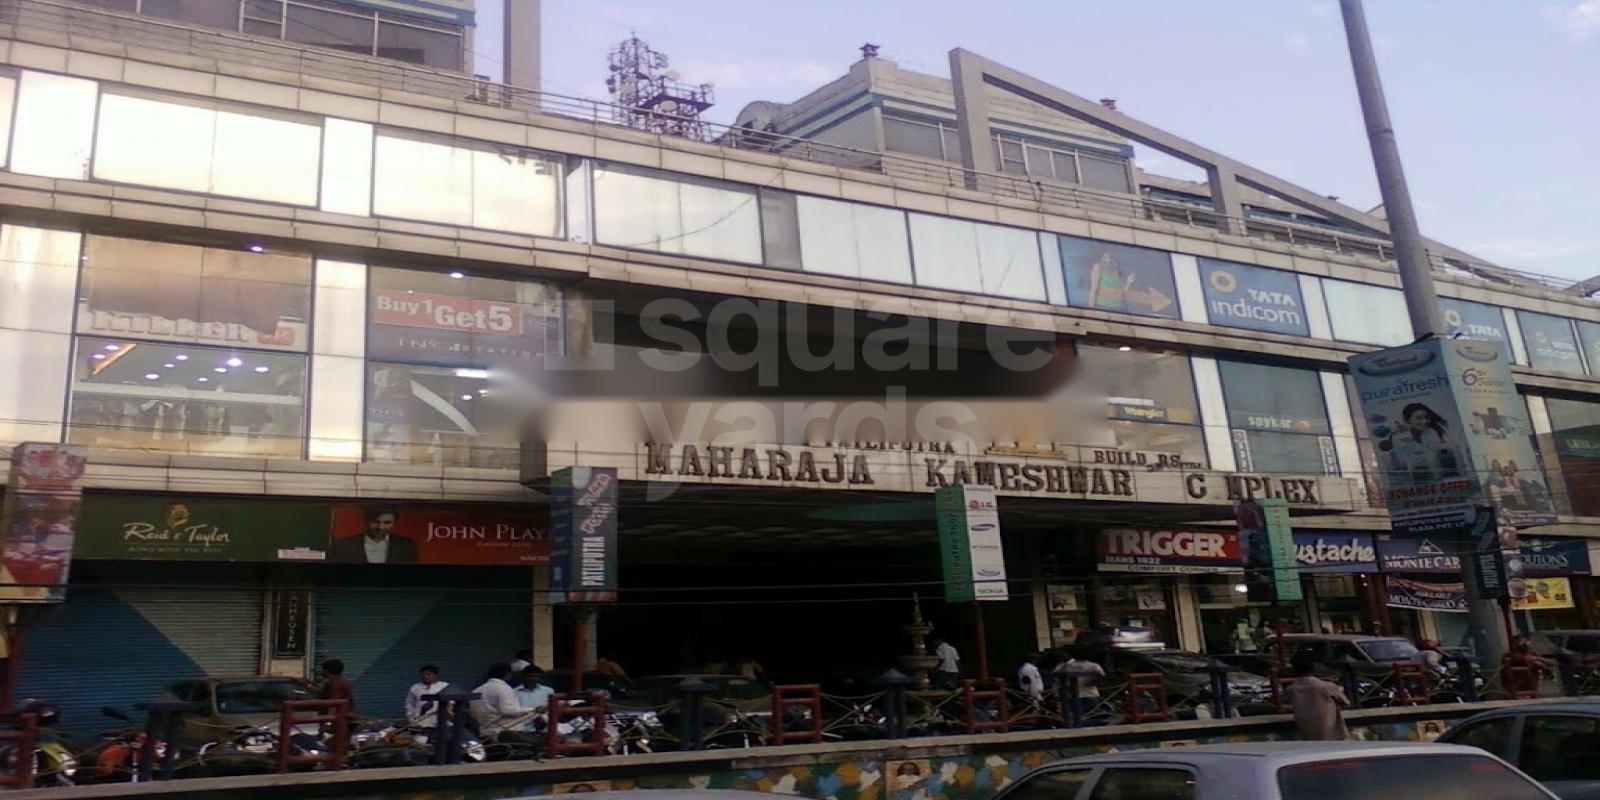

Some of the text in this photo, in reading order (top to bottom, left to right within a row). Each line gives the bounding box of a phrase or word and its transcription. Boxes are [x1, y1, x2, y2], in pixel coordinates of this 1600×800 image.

[1246, 287, 1297, 306] TATA
[376, 296, 419, 315] Buy
[434, 305, 487, 328] Get
[488, 305, 513, 331] 5
[1211, 300, 1302, 325] indicom
[1470, 325, 1503, 338] TATA
[1361, 374, 1450, 404] purafresh
[1249, 416, 1293, 429] spykar
[644, 441, 875, 485] MAHARAJA
[924, 457, 1136, 494] KAMESHWAR
[184, 523, 232, 548] Taylor
[424, 522, 486, 542] JOHN
[1103, 528, 1227, 558] TRIGGER
[581, 537, 605, 586] PATLIPUTRA
[1293, 538, 1376, 564] ustache
